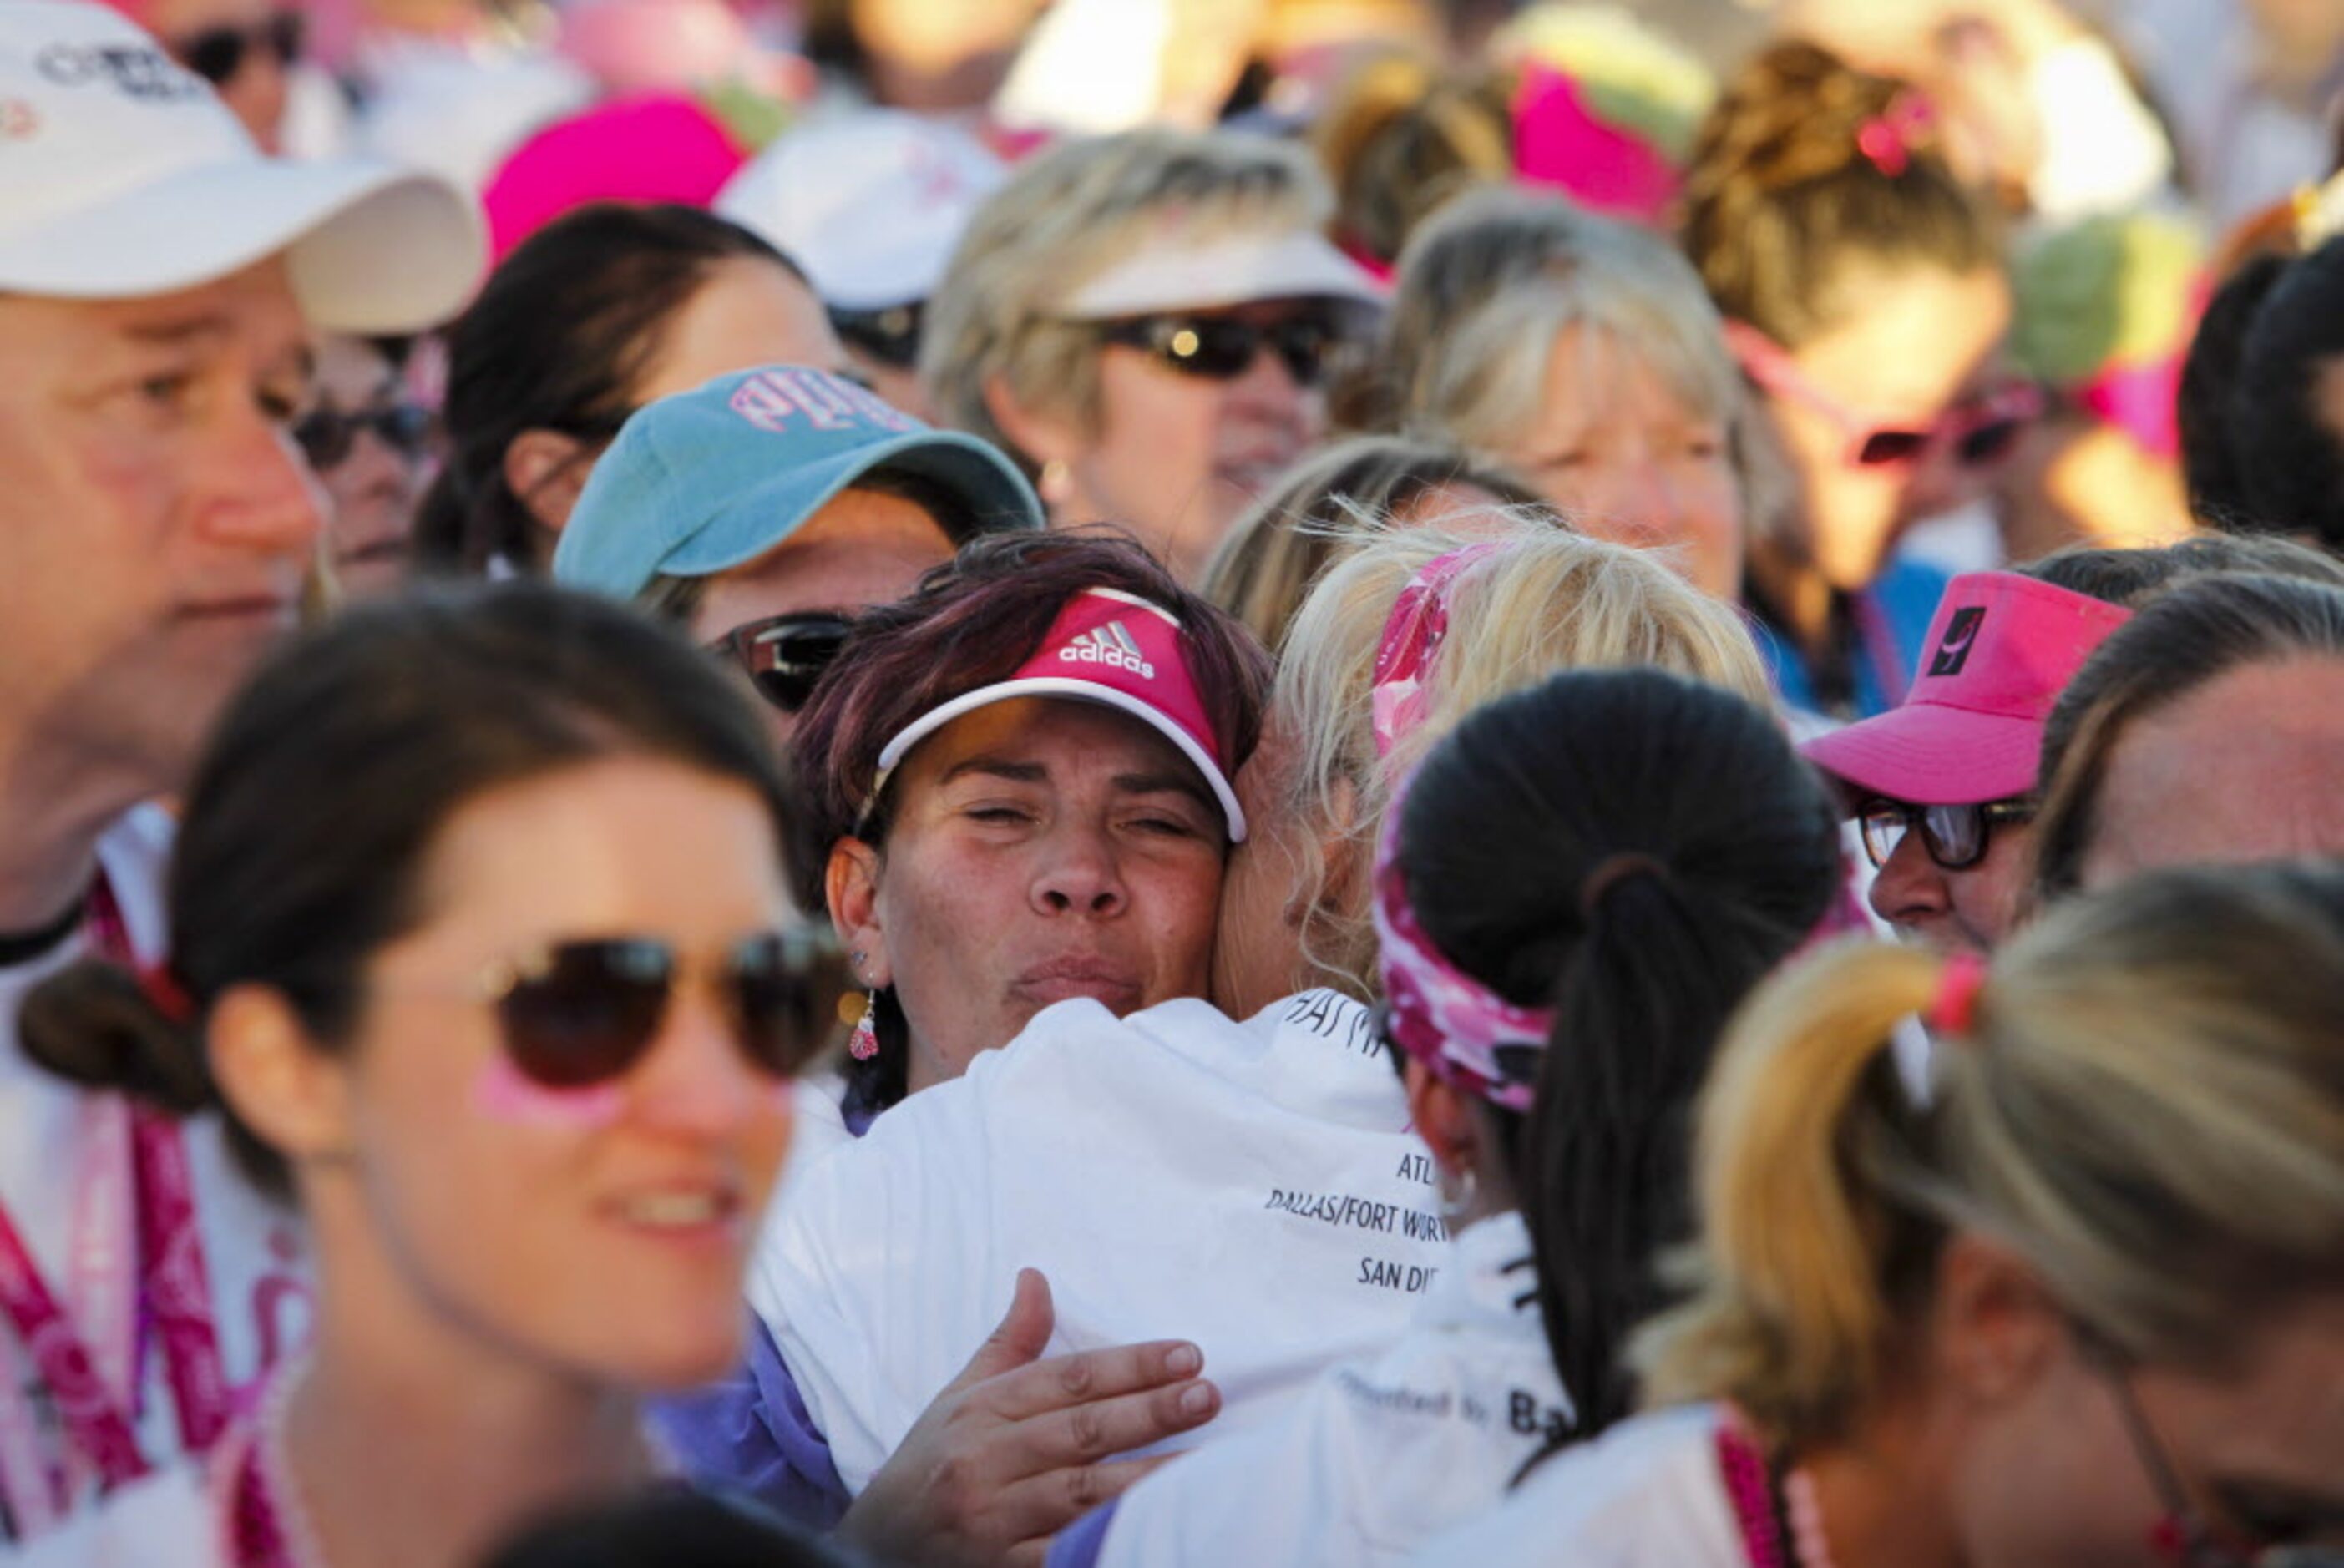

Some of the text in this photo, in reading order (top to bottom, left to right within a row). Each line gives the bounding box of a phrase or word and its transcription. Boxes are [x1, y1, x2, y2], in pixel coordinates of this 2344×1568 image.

[1058, 642, 1155, 680] adidas
[1396, 1153, 1433, 1186] ATL
[1264, 1188, 1448, 1242] DALLAS/FORT WORT
[1357, 1257, 1403, 1290] SAN
[1509, 1388, 1568, 1444] Ba
